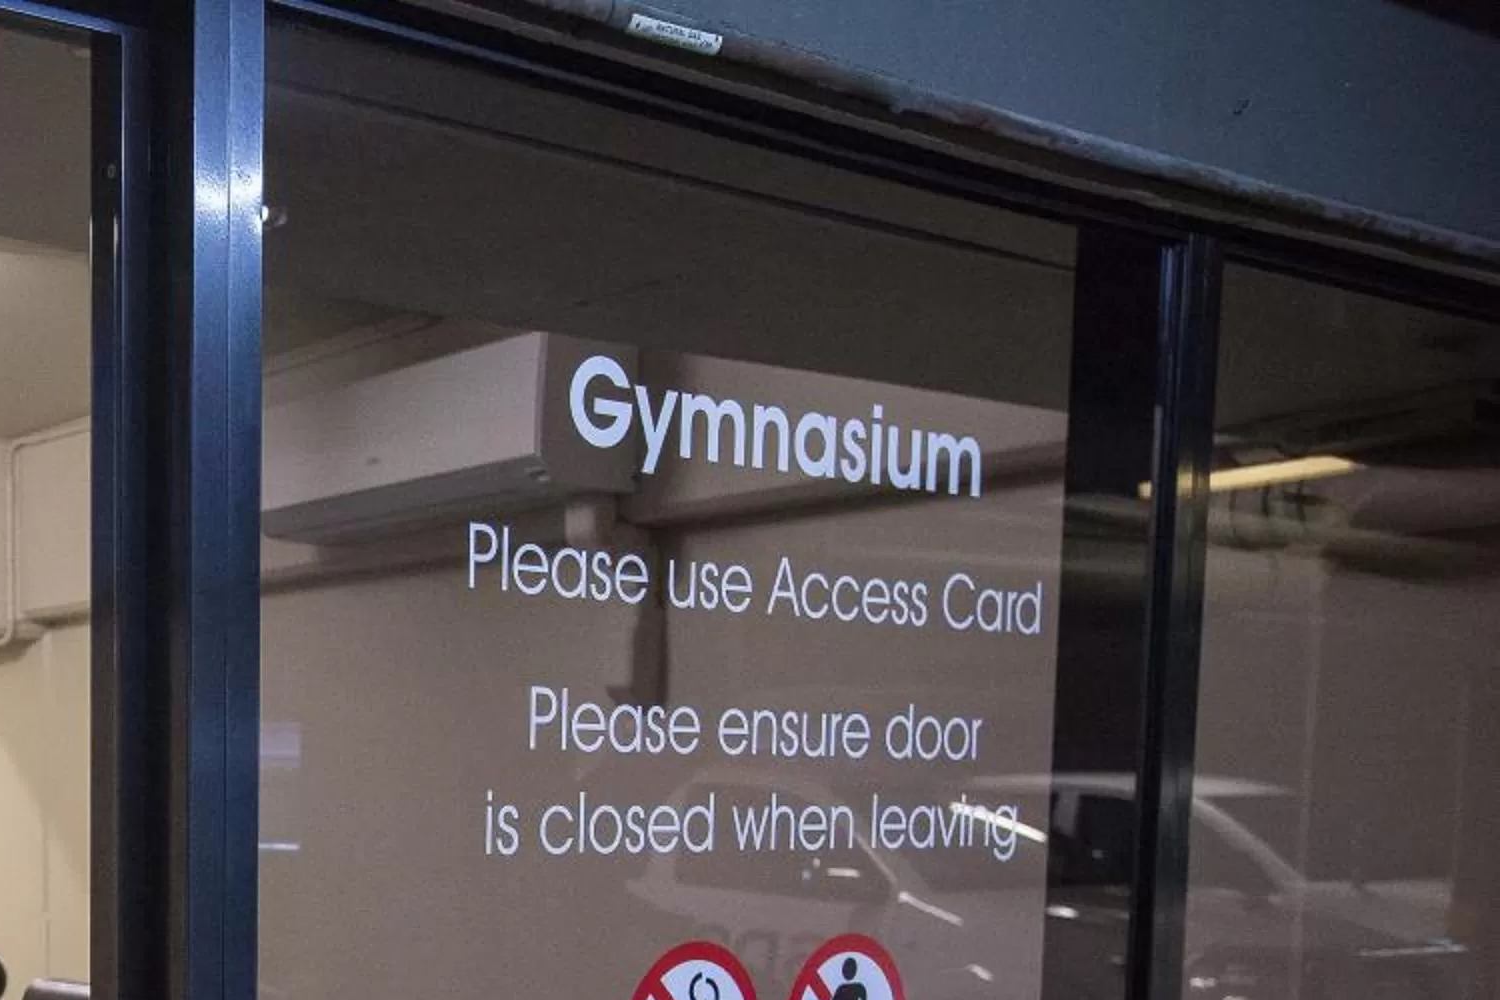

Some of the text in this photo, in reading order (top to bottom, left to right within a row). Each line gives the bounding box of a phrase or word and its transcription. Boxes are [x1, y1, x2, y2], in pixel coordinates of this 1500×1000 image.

[569, 355, 981, 497] Gymnasium
[468, 522, 1043, 635] Please use Access Card
[528, 685, 983, 761] Please ensure door
[485, 790, 1018, 861] is closed when leaving
